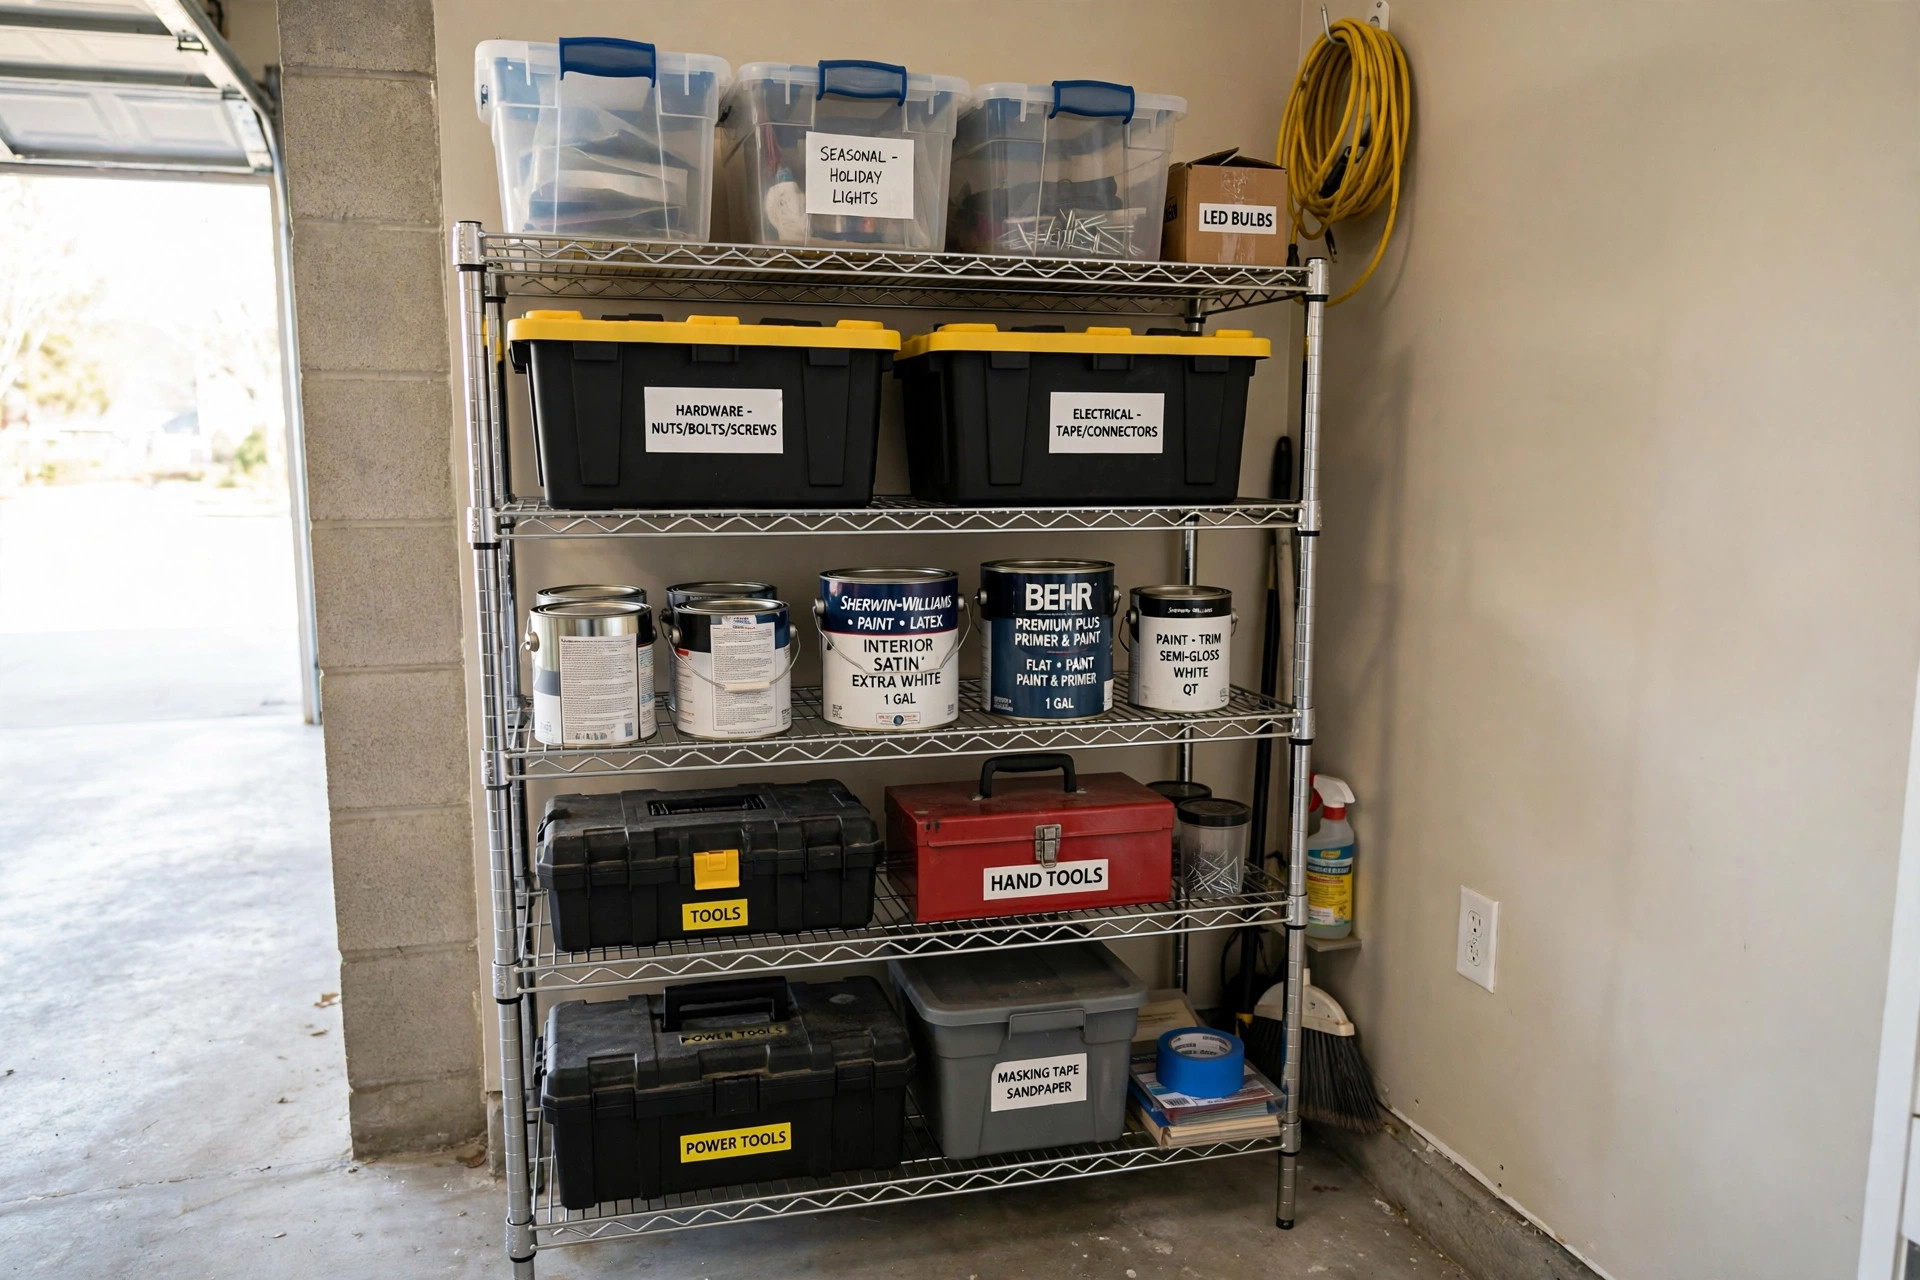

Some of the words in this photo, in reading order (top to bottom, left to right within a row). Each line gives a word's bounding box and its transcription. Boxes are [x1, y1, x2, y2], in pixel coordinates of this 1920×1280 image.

[820, 146, 886, 163] SEASONAL
[830, 168, 882, 185] HOLIDAY
[832, 189, 878, 206] LIGHTS
[1203, 210, 1228, 225] LED
[1231, 211, 1273, 228] BULBS
[676, 404, 744, 417] HARDWARE
[1073, 408, 1134, 420] ELECTRICAL
[651, 422, 777, 437] NUTS/BOLTS/SCREWS
[1056, 425, 1158, 439] TAPE/CONNECTORS
[840, 595, 952, 612] SHERWIN-WILLIAMS
[1025, 582, 1093, 611] BEHR
[857, 616, 895, 631] PAINT
[910, 614, 944, 630] LATEX
[1015, 617, 1072, 632] PREMIUM
[1075, 616, 1100, 630] PLUS
[864, 638, 933, 653] INTERIOR
[1014, 632, 1058, 647] PRIMER
[1061, 634, 1070, 647] &
[1073, 630, 1101, 646] PAINT
[1156, 633, 1188, 646] PAINT
[1199, 633, 1222, 645] TRIM
[1160, 649, 1220, 662] SEMI-GLOSS
[1026, 658, 1052, 672] FLAT
[1065, 656, 1095, 672] PAINT
[1173, 666, 1209, 678] WHITE
[852, 674, 897, 688] EXTRA
[901, 672, 942, 687] WHITE
[1016, 673, 1048, 687] PAINT
[1050, 674, 1059, 687] &
[1061, 672, 1097, 687] PRIMER
[1183, 683, 1199, 696] QT
[884, 694, 889, 705] 1
[893, 693, 916, 705] GAL
[1045, 697, 1051, 710] 1
[1053, 697, 1075, 710] GAL
[991, 872, 1042, 892] HAND
[1046, 867, 1103, 887] TOOLS
[690, 906, 741, 923] TOOLS
[997, 1067, 1050, 1084] MASKING
[1053, 1064, 1079, 1077] TAPE
[1006, 1081, 1072, 1099] SANDPAPER
[686, 1137, 737, 1155] POWER
[740, 1131, 786, 1148] TOOLS
